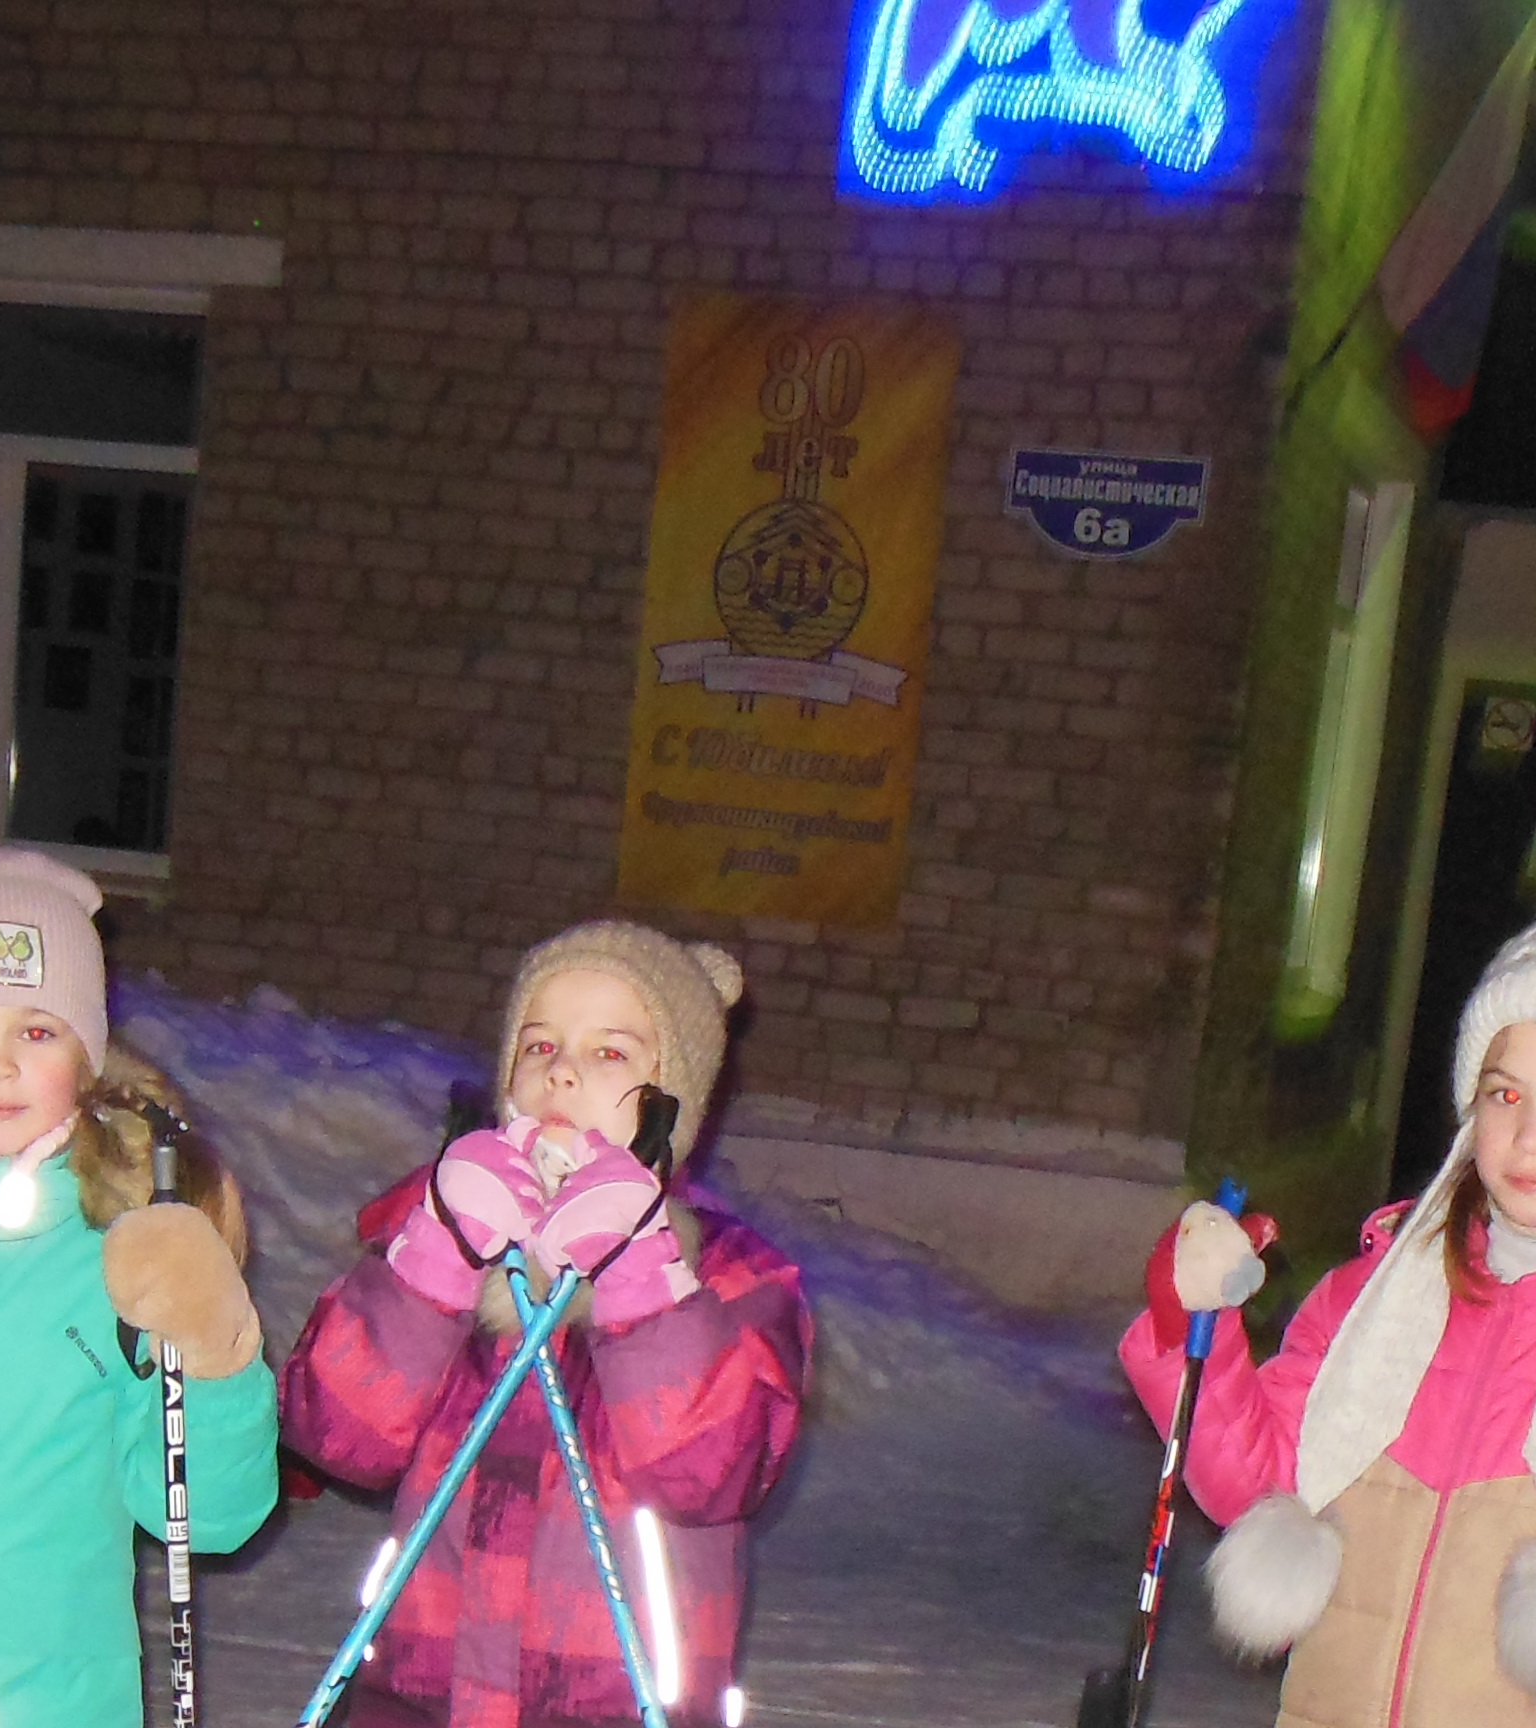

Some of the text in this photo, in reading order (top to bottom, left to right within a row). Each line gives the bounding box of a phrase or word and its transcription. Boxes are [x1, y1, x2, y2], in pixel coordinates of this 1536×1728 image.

[759, 334, 864, 427] 80
[1080, 461, 1138, 475] улица
[1015, 469, 1201, 507] Социалистическая
[1074, 508, 1132, 545] 6а
[164, 1341, 187, 1519] SABLE
